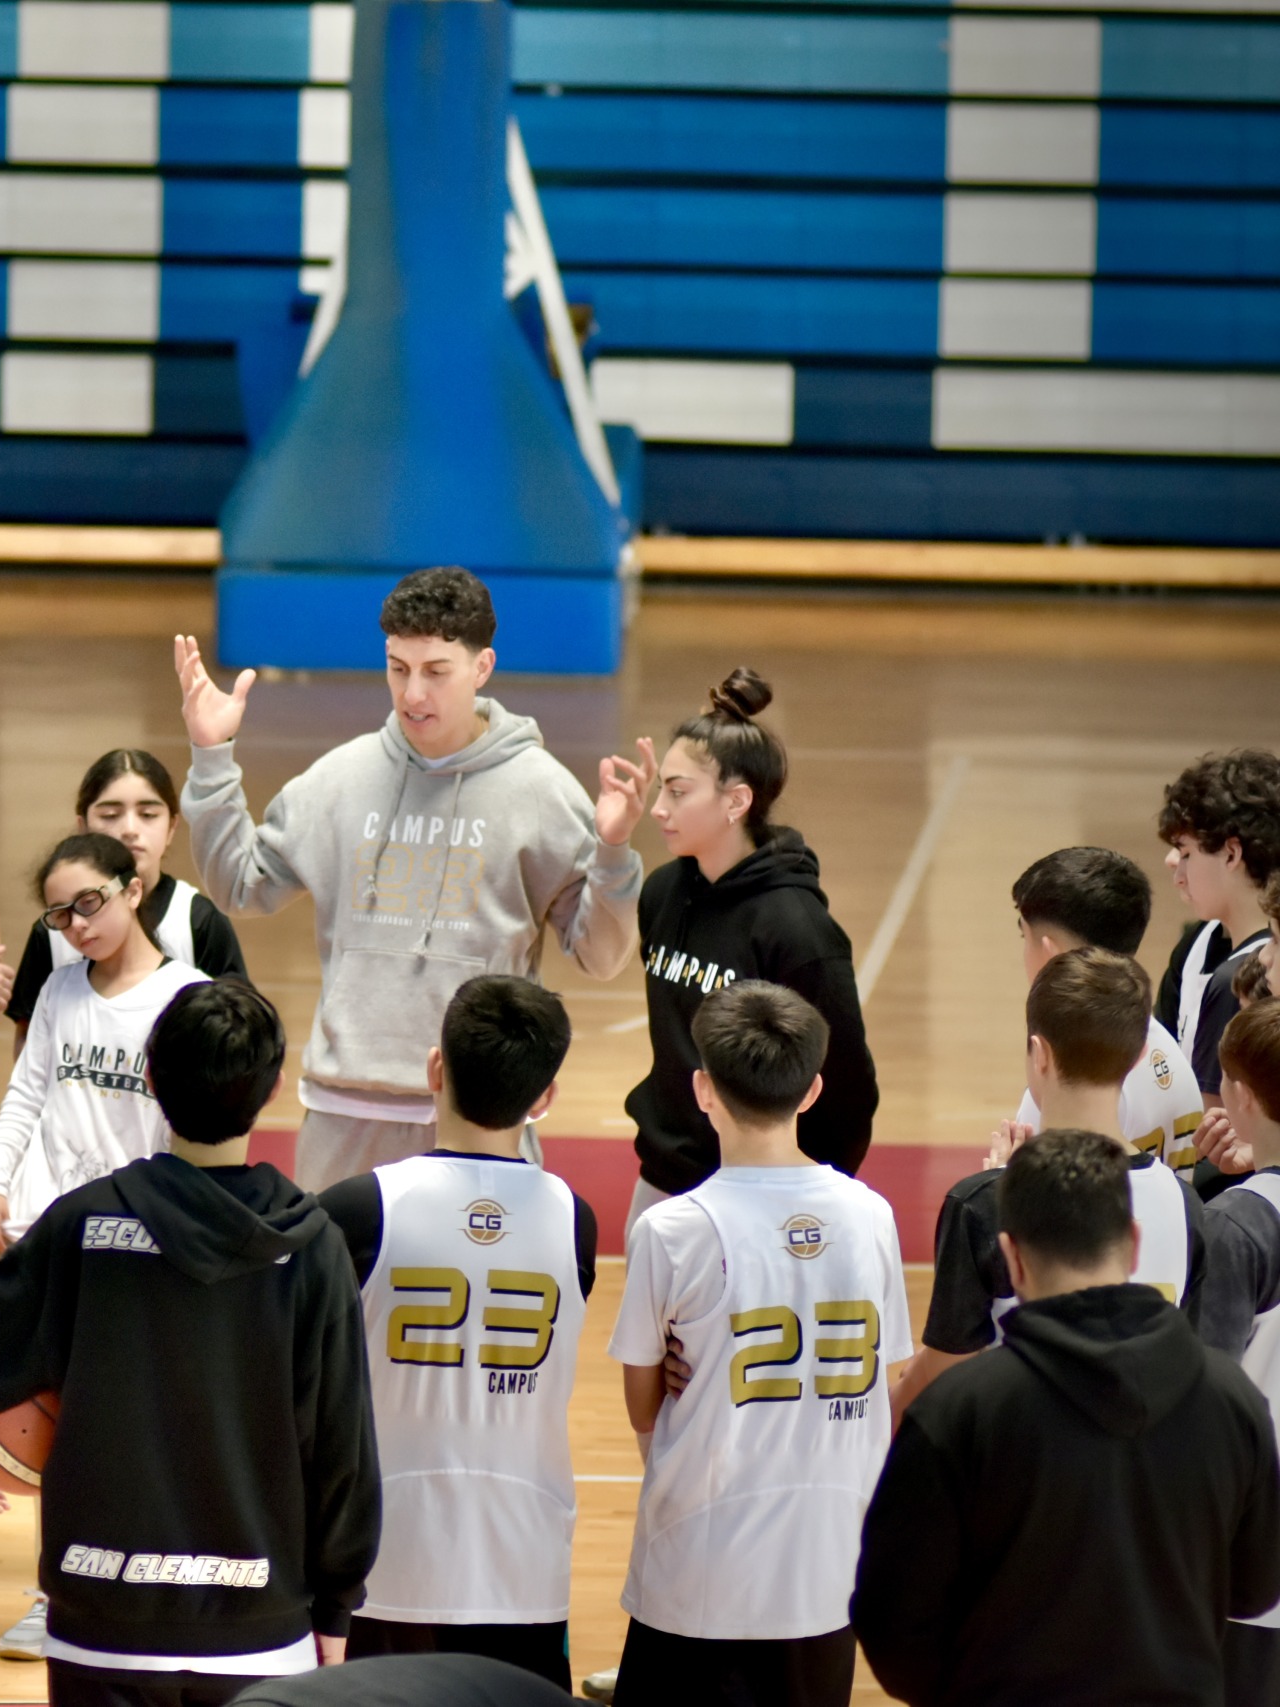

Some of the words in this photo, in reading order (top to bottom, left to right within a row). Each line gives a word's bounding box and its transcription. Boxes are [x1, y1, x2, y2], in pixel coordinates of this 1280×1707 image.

[352, 842, 485, 917] 23
[62, 1043, 146, 1075] CMPU
[58, 1066, 155, 1098] BASETBAL
[82, 1216, 161, 1254] ESCU
[469, 1213, 502, 1230] CG
[788, 1227, 821, 1245] CG
[386, 1267, 561, 1371] 23
[729, 1299, 881, 1408] 23
[488, 1371, 538, 1394] CAMPUS
[61, 1544, 125, 1580] SAN
[122, 1553, 270, 1588] CLEMENTE
